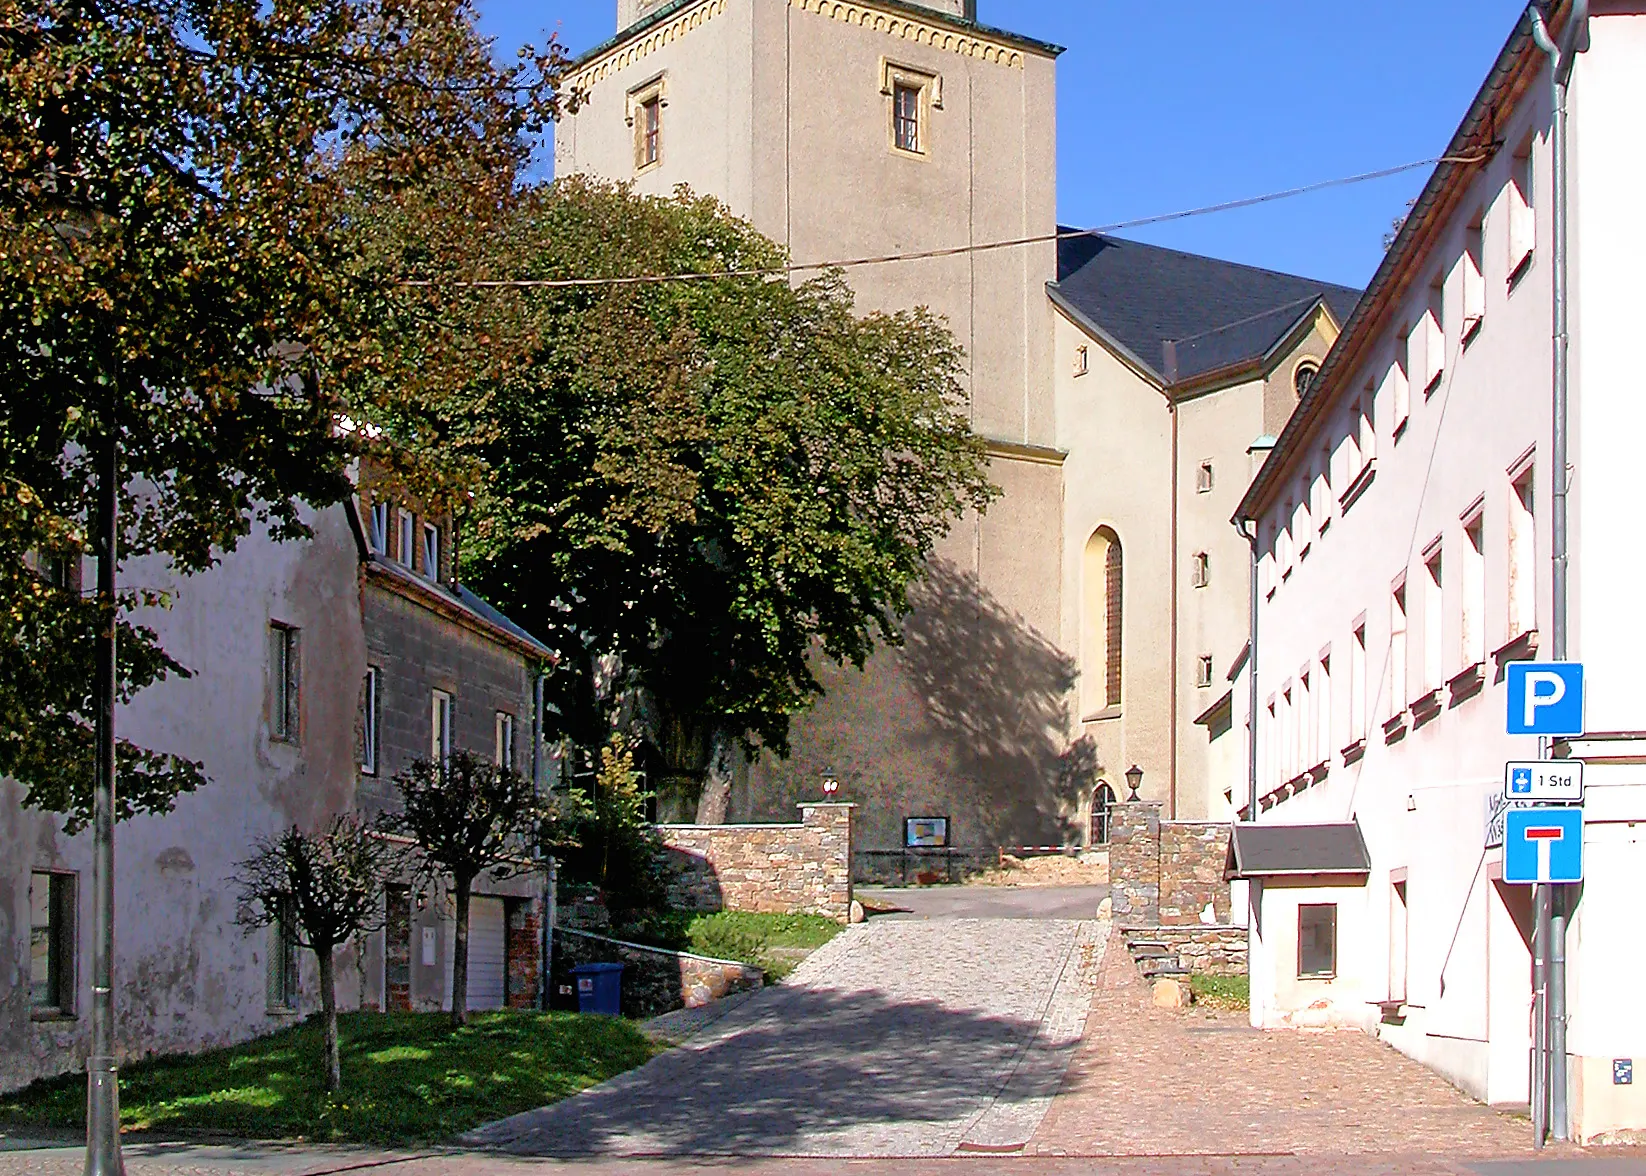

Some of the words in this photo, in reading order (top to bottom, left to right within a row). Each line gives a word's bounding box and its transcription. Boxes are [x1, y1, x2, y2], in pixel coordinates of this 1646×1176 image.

[1524, 672, 1566, 727] P
[1539, 775, 1543, 786] 1
[1549, 775, 1571, 787] Std
